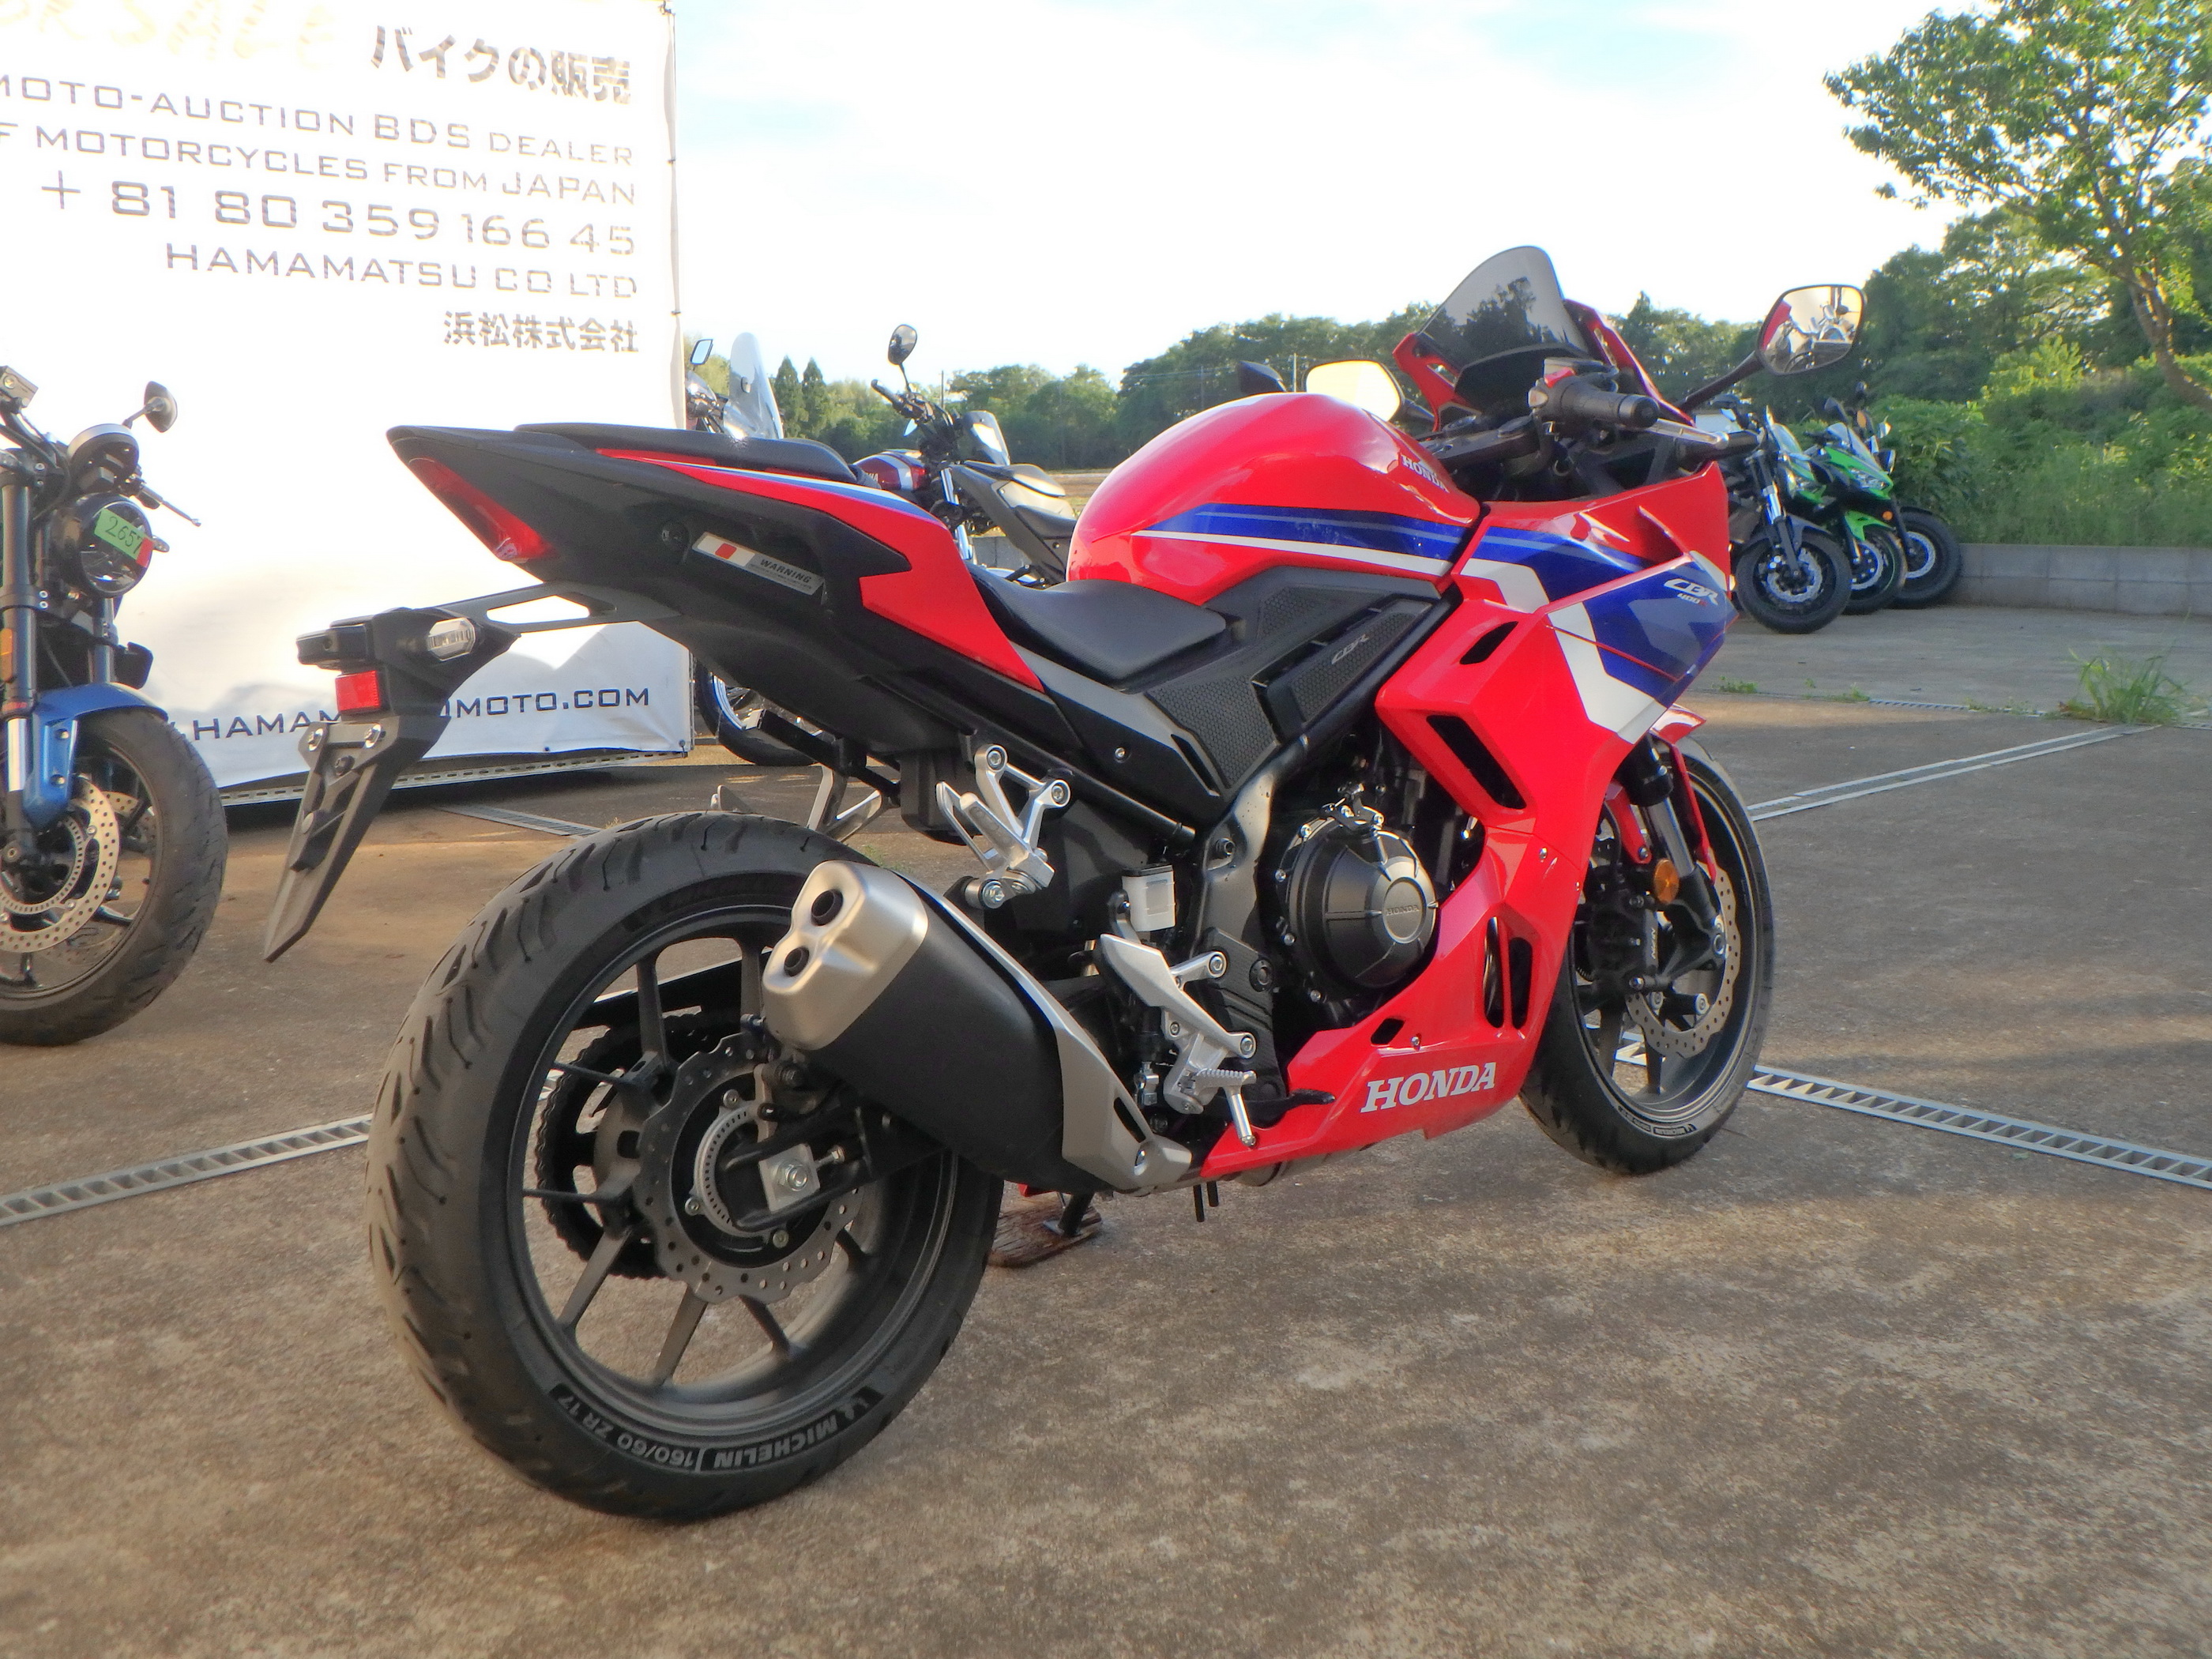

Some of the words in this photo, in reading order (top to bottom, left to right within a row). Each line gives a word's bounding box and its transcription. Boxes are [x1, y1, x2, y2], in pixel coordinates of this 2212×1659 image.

[371, 24, 630, 104] バイクの販売
[36, 125, 367, 180] MOTORCYCLES
[384, 163, 487, 191] FROM
[502, 171, 634, 205] JAPAN
[374, 114, 471, 148] BDS
[489, 132, 632, 165] DEALER
[112, 181, 176, 219] 81
[215, 190, 297, 228] 80
[322, 200, 440, 240] 359
[461, 213, 551, 249] 166
[570, 224, 635, 256] 45
[166, 243, 476, 289] HAMAMATSU
[495, 268, 552, 293] CO
[570, 273, 637, 299] LTD
[444, 310, 639, 353] 浜松株式会社
[760, 559, 812, 584] WARNING
[1386, 905, 1420, 916] HONDA
[1360, 1062, 1497, 1113] HONDA
[557, 1394, 581, 1416] 17
[582, 1412, 614, 1439] ZR
[617, 1432, 694, 1468] 160/60
[713, 1415, 838, 1469] MICHELIN
